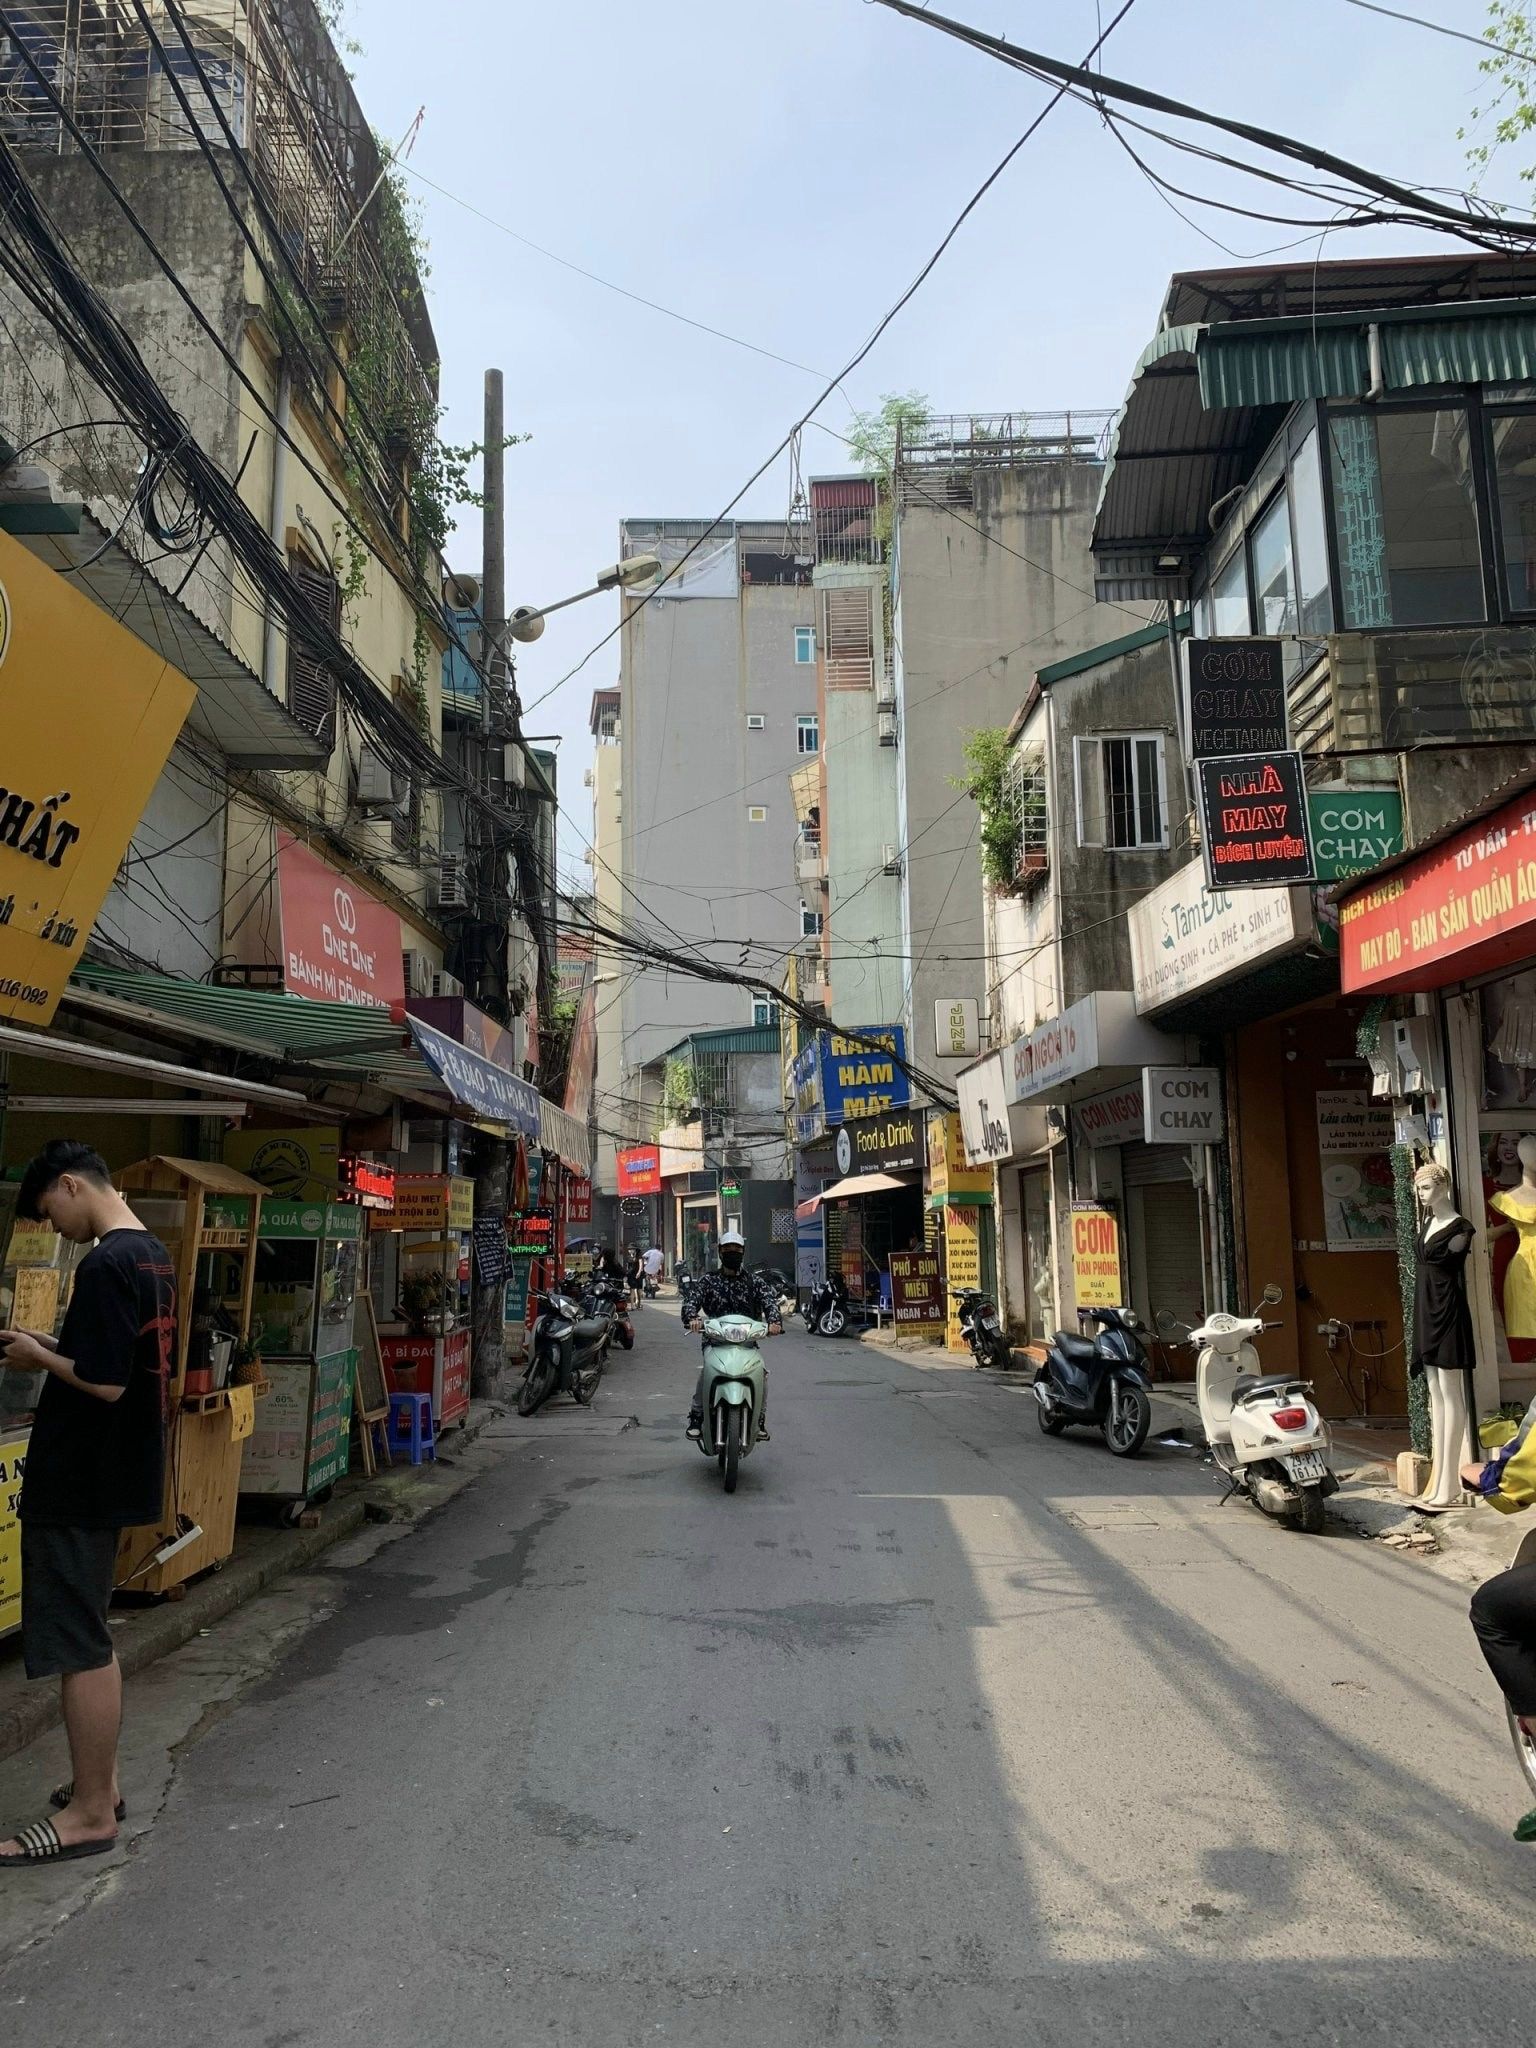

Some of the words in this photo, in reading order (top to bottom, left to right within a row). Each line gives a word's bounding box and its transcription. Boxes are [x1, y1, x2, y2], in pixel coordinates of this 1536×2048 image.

[1201, 647, 1272, 681] CƠM
[1193, 689, 1283, 719] CHAY
[1193, 729, 1285, 750] VEGETARIAN
[1221, 765, 1284, 797] NHÀ
[1222, 805, 1287, 833] MAY
[1320, 808, 1386, 832] CƠM
[1215, 842, 1253, 864] BÍCH
[1256, 834, 1305, 860] LUYỆN
[1316, 838, 1395, 860] CHAY
[1455, 844, 1474, 872] TƯ
[1476, 827, 1509, 862] VẤN
[1340, 900, 1366, 926] BÍCH
[1367, 877, 1406, 912] LUYỆN
[1171, 902, 1201, 942] Tâm
[1360, 936, 1385, 972] MAY
[1386, 927, 1402, 962] ĐO
[1411, 911, 1438, 952] BÁN
[1440, 892, 1470, 940] SẴN
[1471, 866, 1514, 927] QUẦN
[1181, 947, 1199, 971] SINH
[1208, 936, 1220, 956] CÀ
[1222, 922, 1239, 947] PHÊ
[1248, 904, 1272, 934] SINH
[289, 950, 323, 992] BÁNH
[324, 967, 337, 999] MÌ
[838, 1060, 894, 1087] HÀM
[1161, 1080, 1209, 1099] CƠM
[1080, 1101, 1111, 1131] CƠM
[1160, 1111, 1214, 1129] CHAY
[1340, 1111, 1365, 1126] chay
[857, 1127, 878, 1153] Food
[879, 1131, 886, 1149] &
[887, 1119, 915, 1148] Drink
[578, 1205, 589, 1218] XE
[948, 1210, 976, 1226] MOON
[1075, 1214, 1116, 1255] CƠM
[892, 1256, 911, 1277] PHỞ
[918, 1257, 938, 1276] BÚN
[1076, 1259, 1091, 1276] VĂN
[1092, 1258, 1119, 1276] PHÒNG
[896, 1307, 921, 1320] NGAN
[928, 1304, 941, 1319] GÀ
[396, 1345, 407, 1358] BÍ
[1291, 1463, 1326, 1481] 161.11
